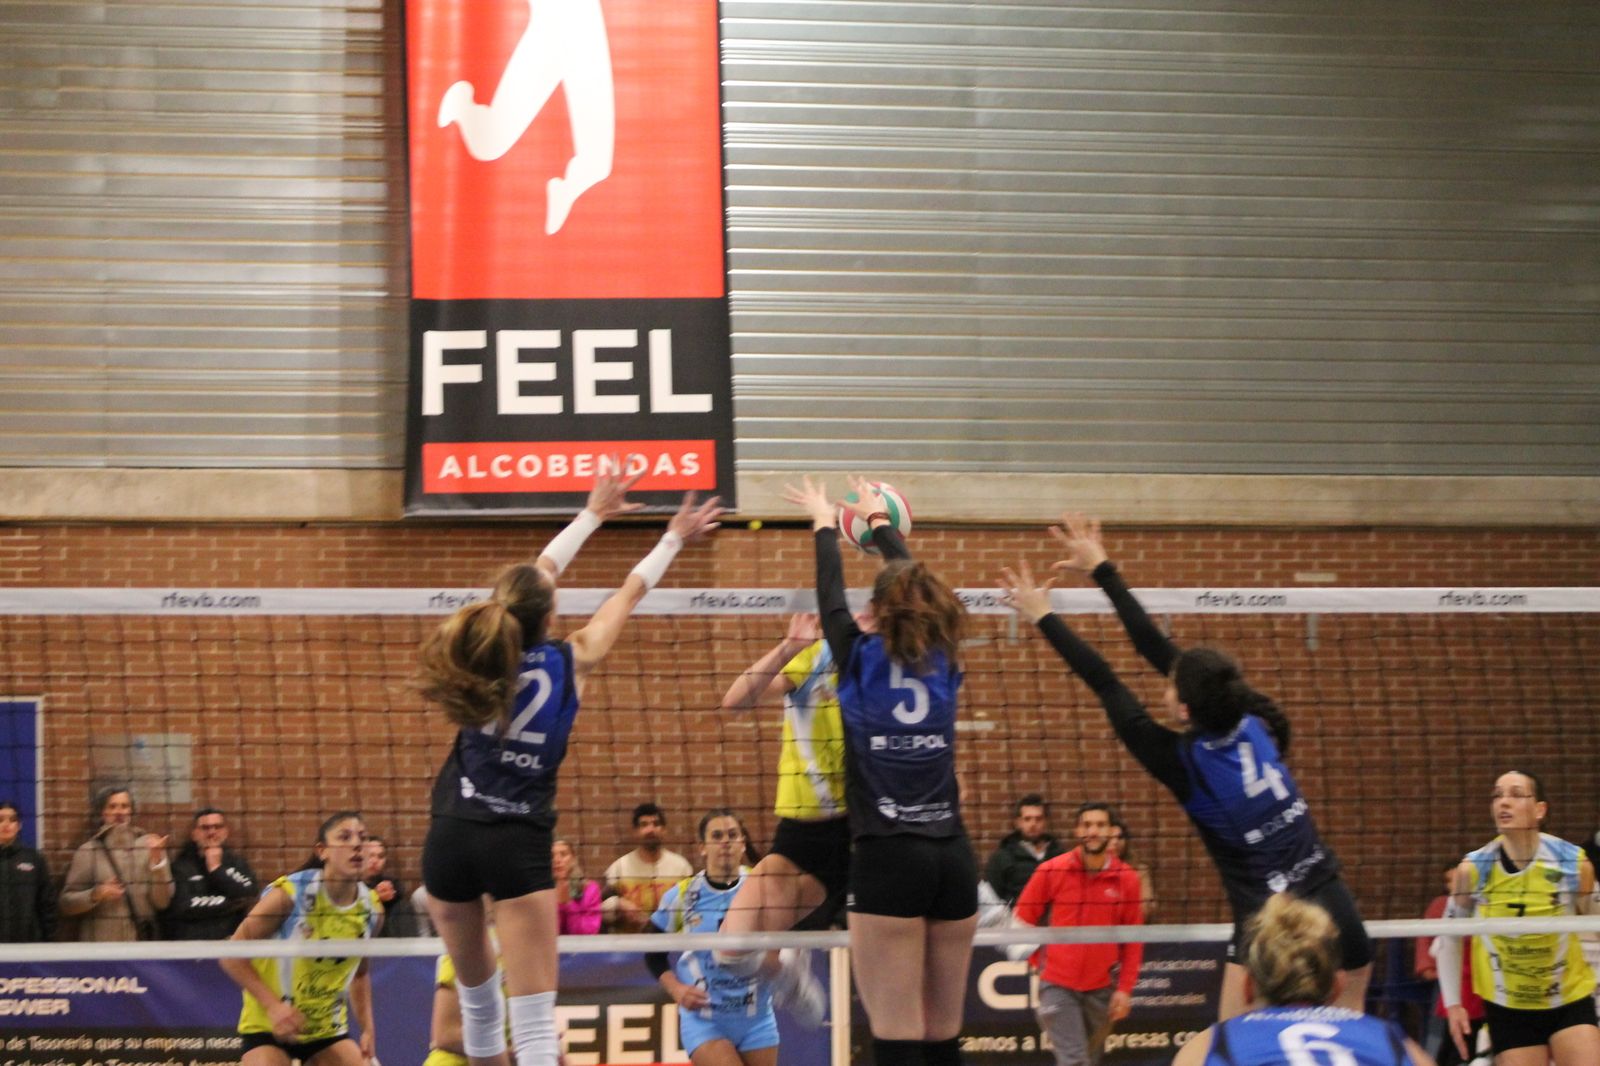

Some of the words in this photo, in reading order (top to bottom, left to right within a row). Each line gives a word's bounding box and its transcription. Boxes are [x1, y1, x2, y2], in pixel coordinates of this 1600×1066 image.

[422, 329, 712, 415] FEEL
[438, 452, 700, 479] ALCOBENDAS
[161, 592, 262, 609] rfevb.com
[428, 591, 480, 608] rfevb
[690, 592, 786, 609] rfevb.com
[1195, 591, 1287, 608] rfevb.com
[1438, 591, 1528, 608] rfevb.com
[889, 660, 931, 725] 5
[481, 668, 553, 744] 2
[502, 750, 544, 769] POL
[1237, 741, 1291, 801] 4
[556, 1003, 693, 1064] EEL
[1021, 1035, 1036, 1051] a
[6, 1036, 27, 1050] de
[28, 1035, 94, 1050] Tesorería
[95, 1038, 124, 1053] que
[125, 1038, 142, 1050] su
[143, 1038, 204, 1053] empresa
[206, 1038, 242, 1050] nece
[1277, 1022, 1360, 1066] 6
